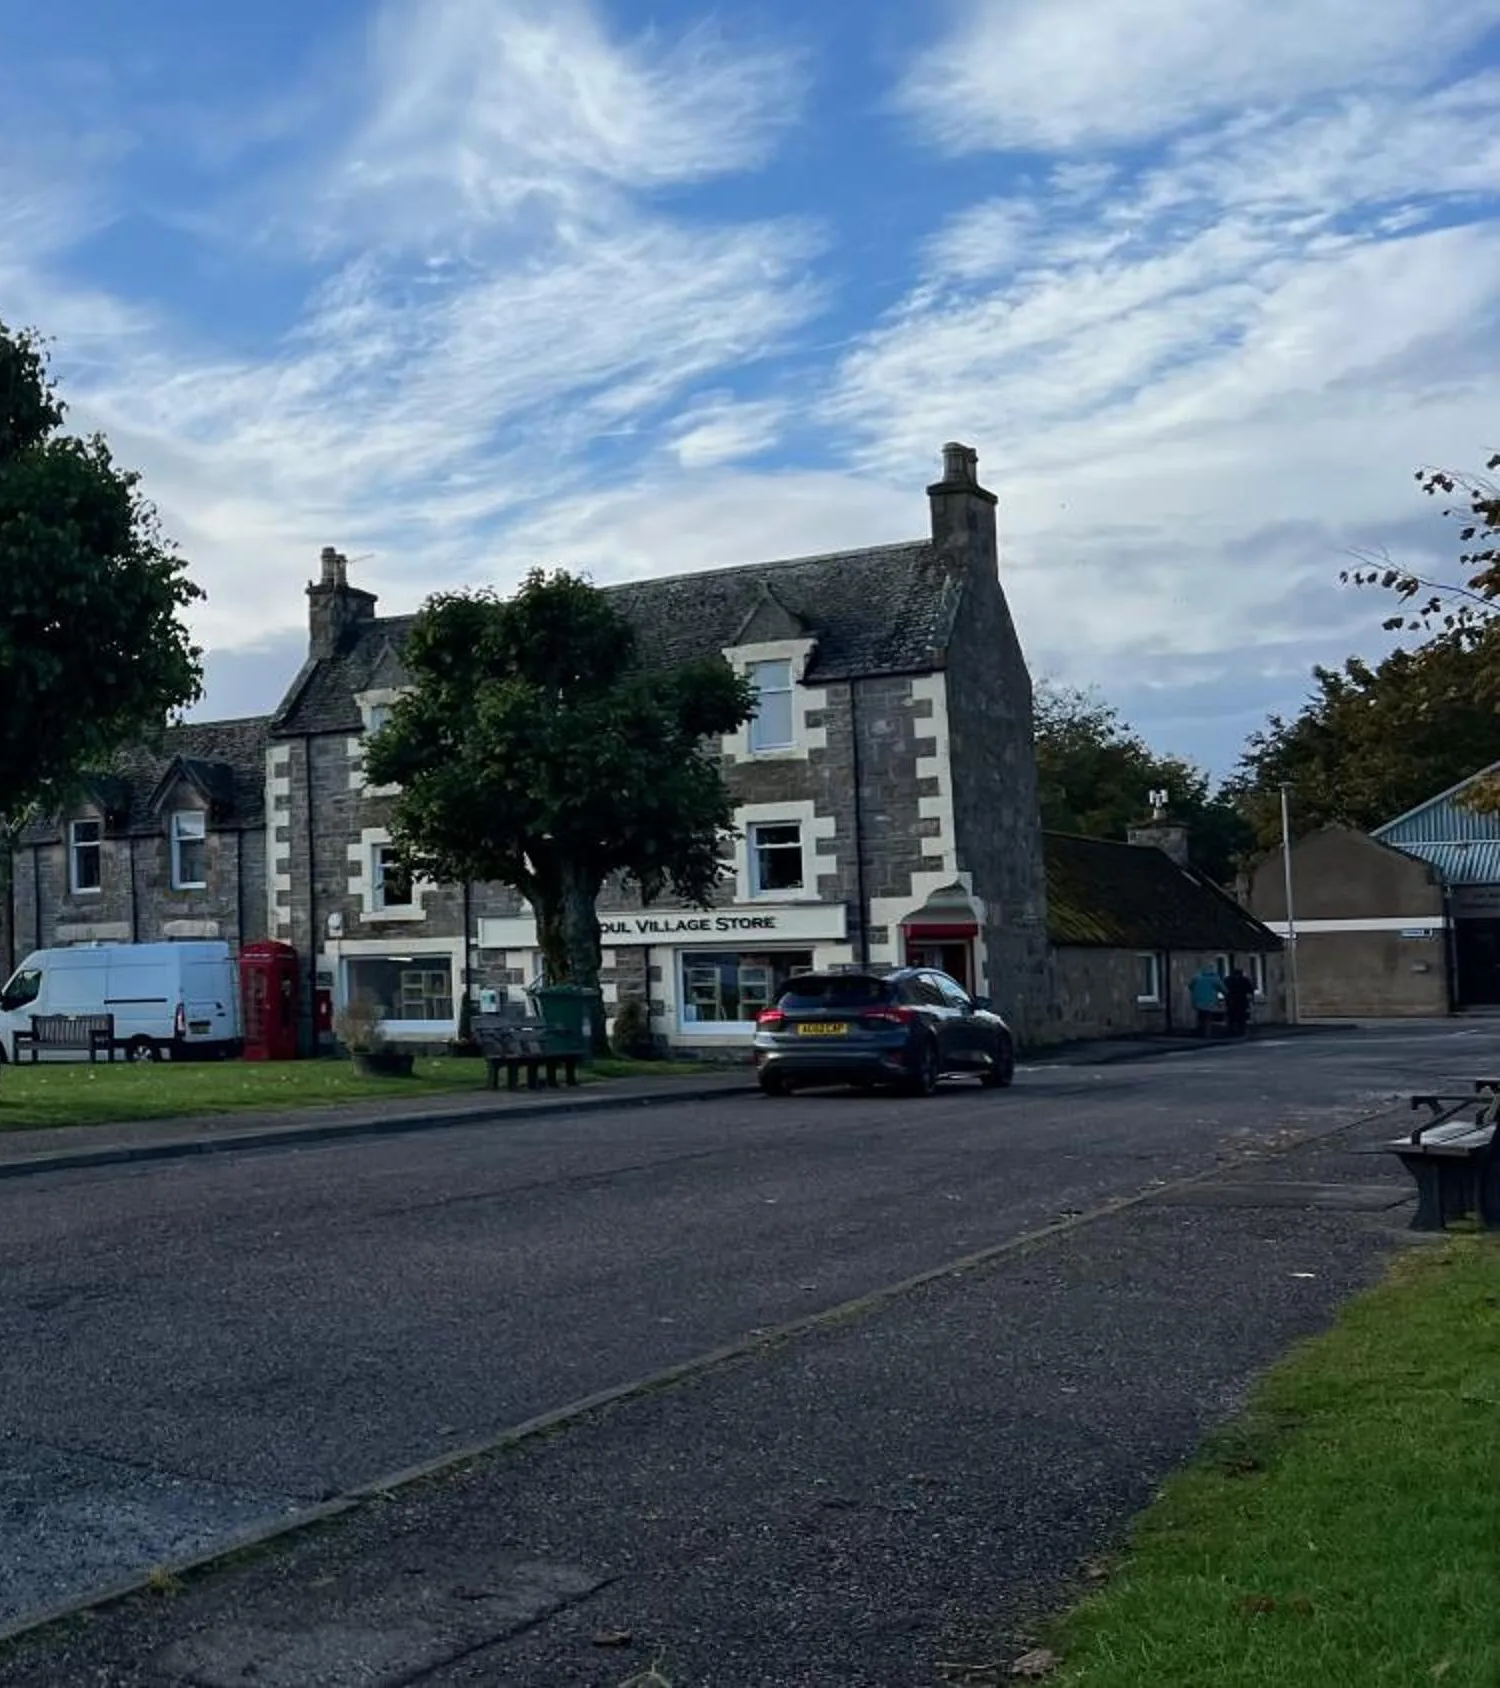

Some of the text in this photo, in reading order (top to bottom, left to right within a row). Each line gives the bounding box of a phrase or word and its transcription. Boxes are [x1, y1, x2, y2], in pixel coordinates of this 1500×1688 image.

[599, 917, 776, 933] OUL VILLAGE STORE
